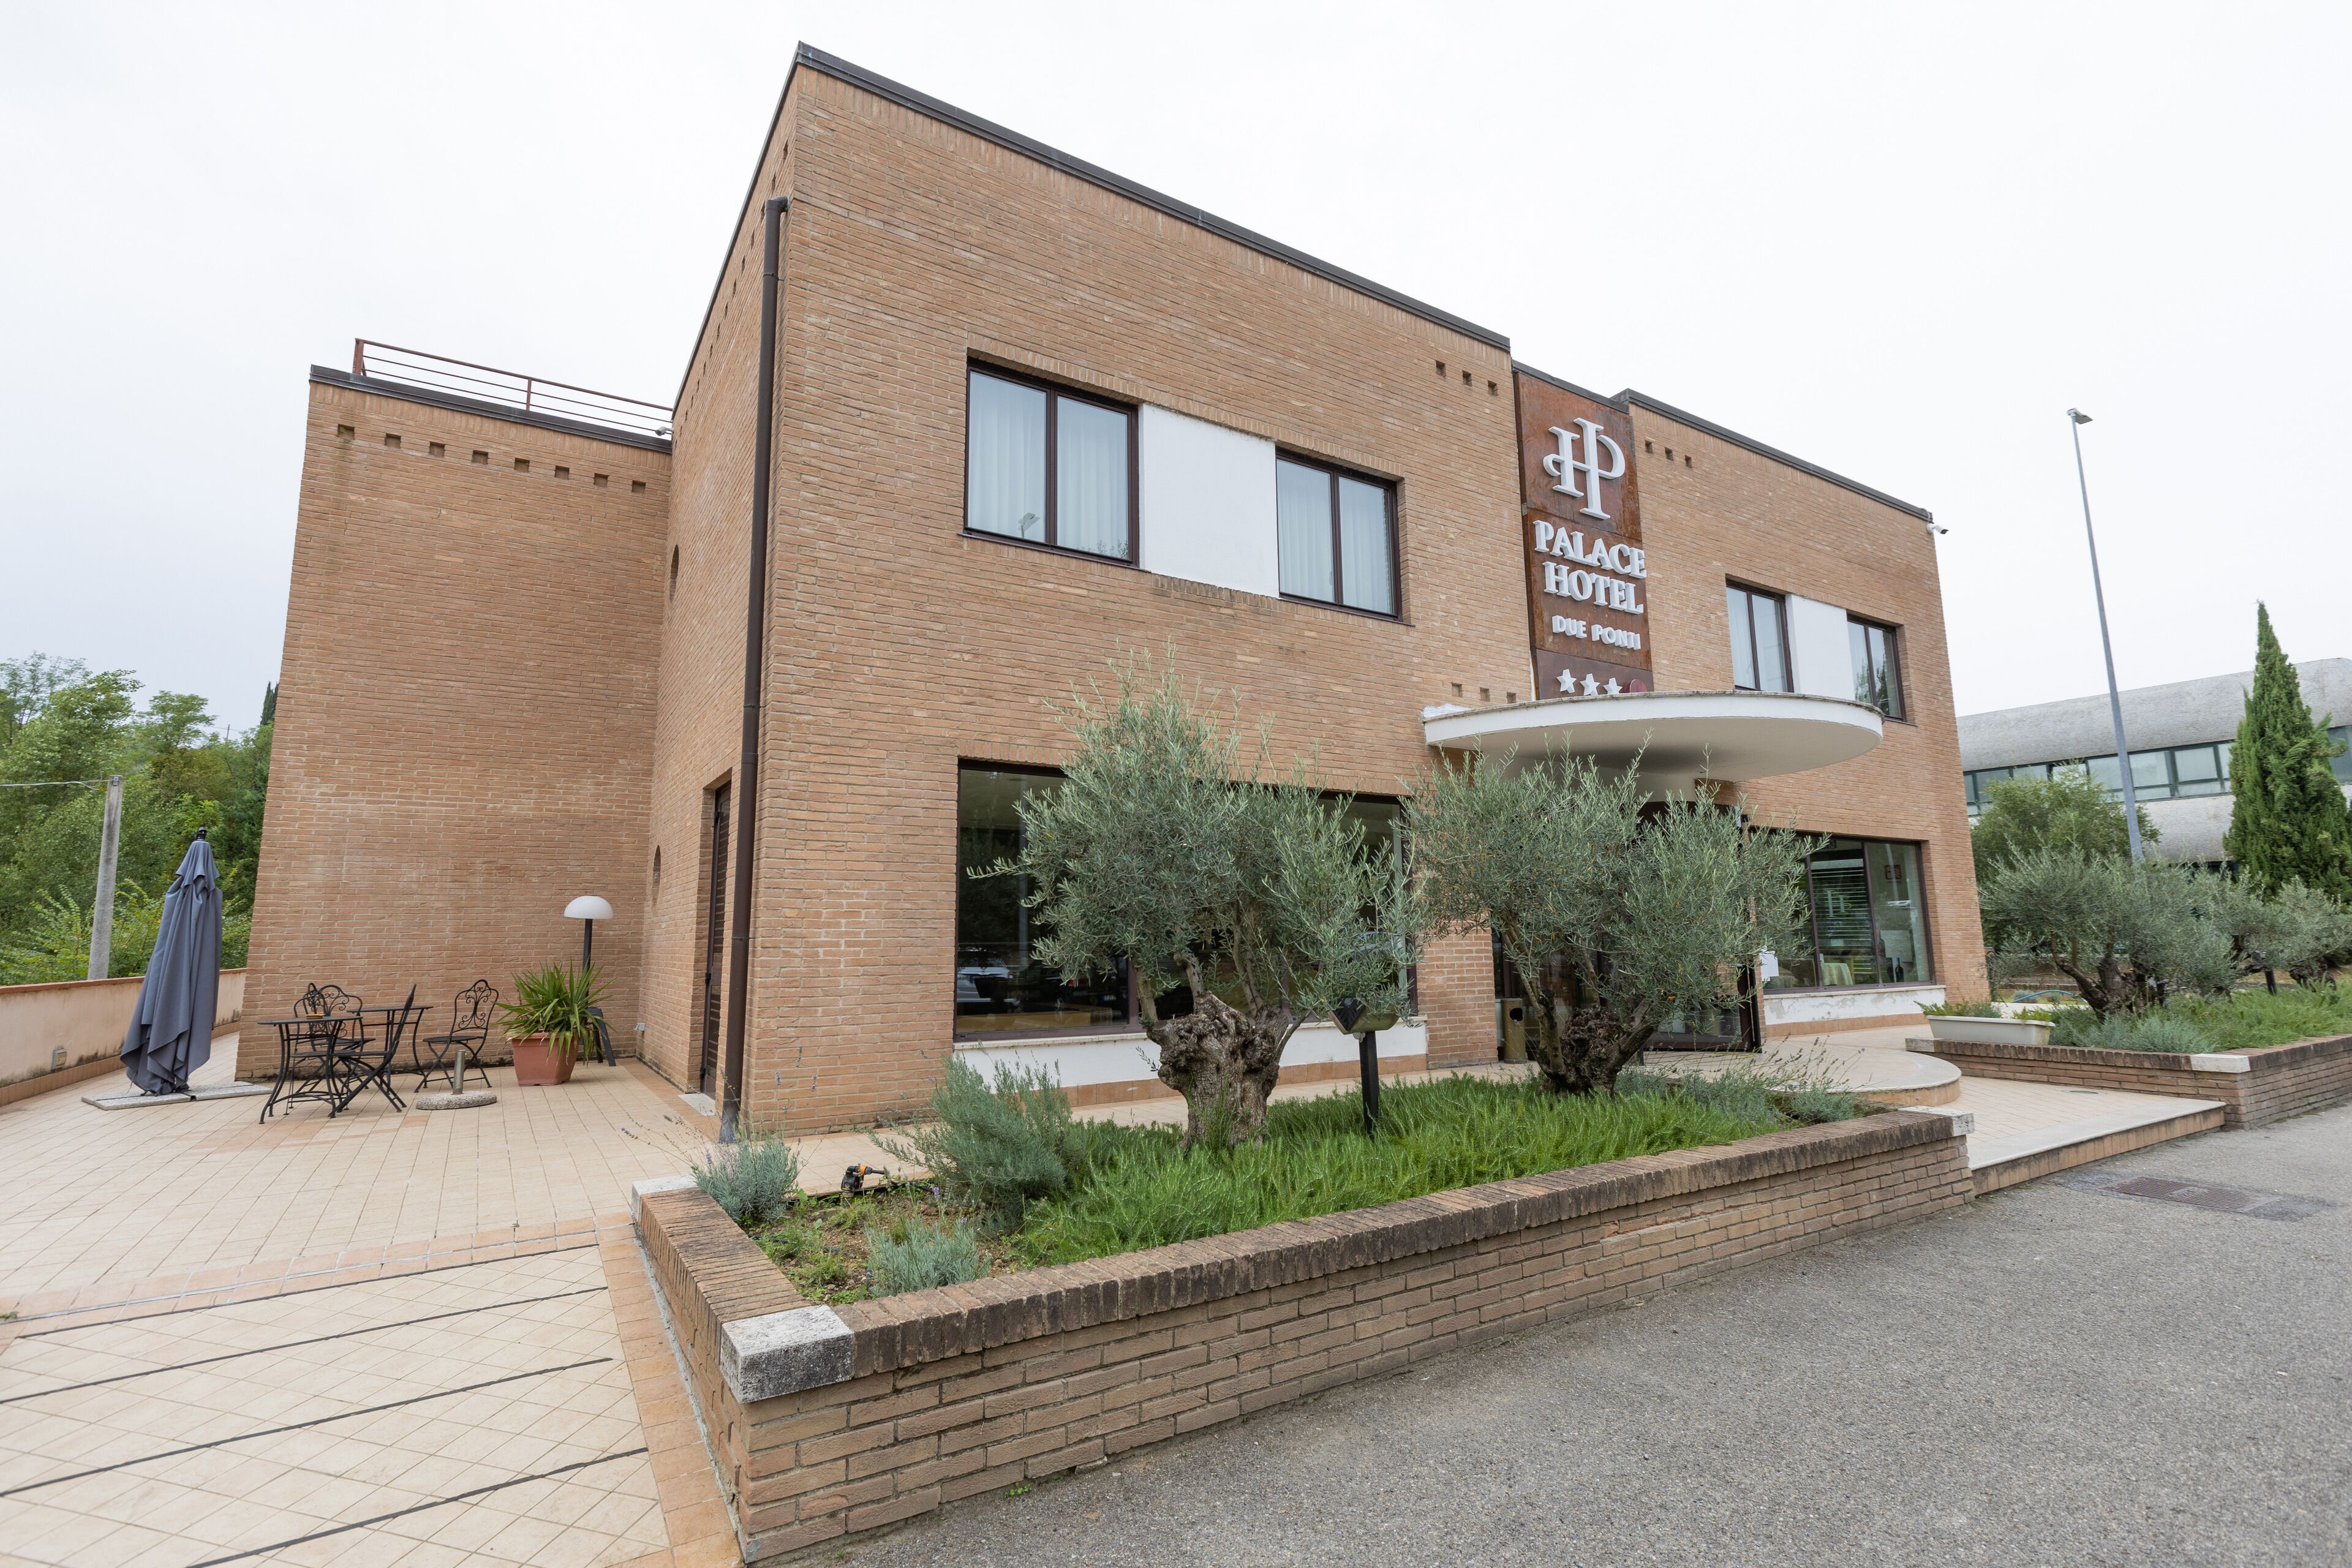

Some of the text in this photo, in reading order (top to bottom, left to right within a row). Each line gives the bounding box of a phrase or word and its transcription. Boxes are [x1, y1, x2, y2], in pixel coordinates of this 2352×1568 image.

[1532, 519, 1647, 579] PALACE
[1542, 561, 1644, 614] HOTEL
[1552, 615, 1641, 650] DUE PONTI
